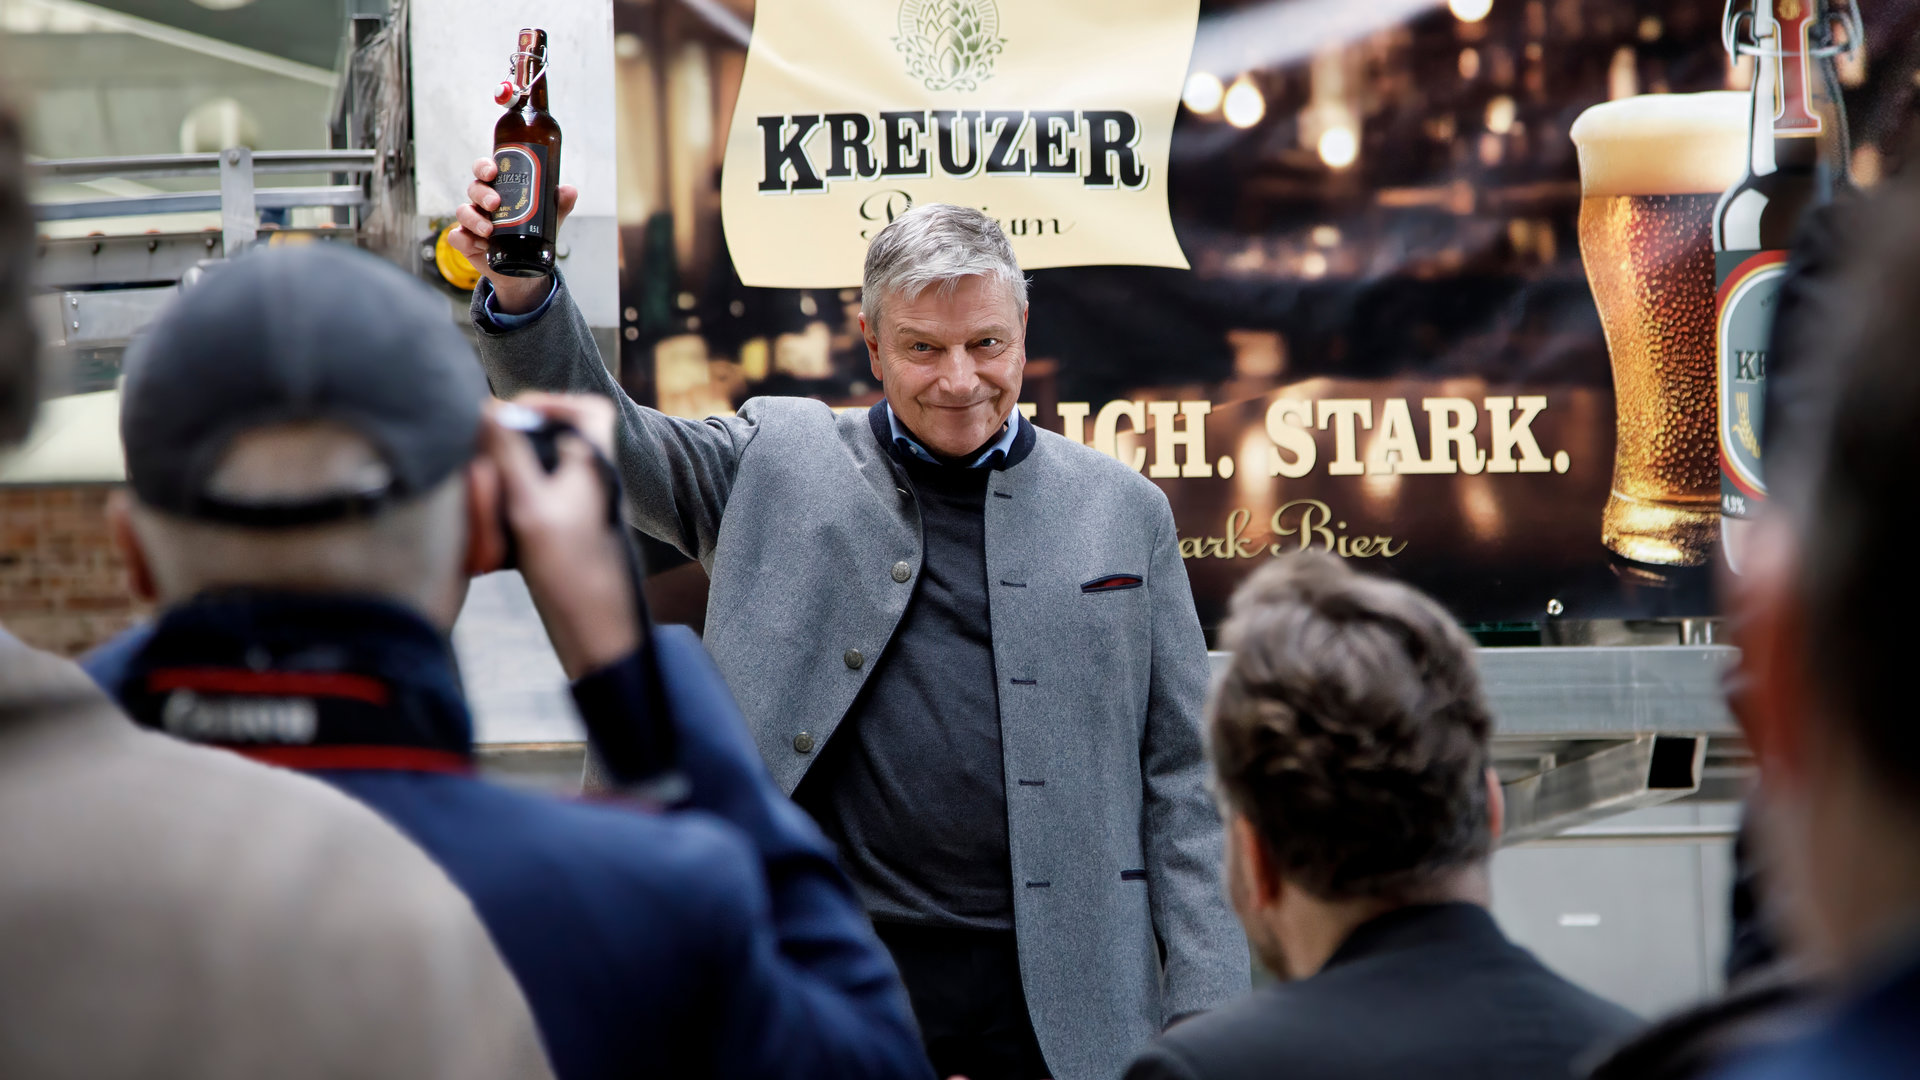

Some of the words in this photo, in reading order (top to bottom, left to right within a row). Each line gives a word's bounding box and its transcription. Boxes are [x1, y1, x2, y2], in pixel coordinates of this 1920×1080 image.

[495, 172, 529, 185] EUZER
[757, 109, 1150, 195] KREUZER
[1265, 396, 1571, 478] STARK.
[1178, 508, 1268, 559] ark
[1270, 498, 1409, 559] Bier
